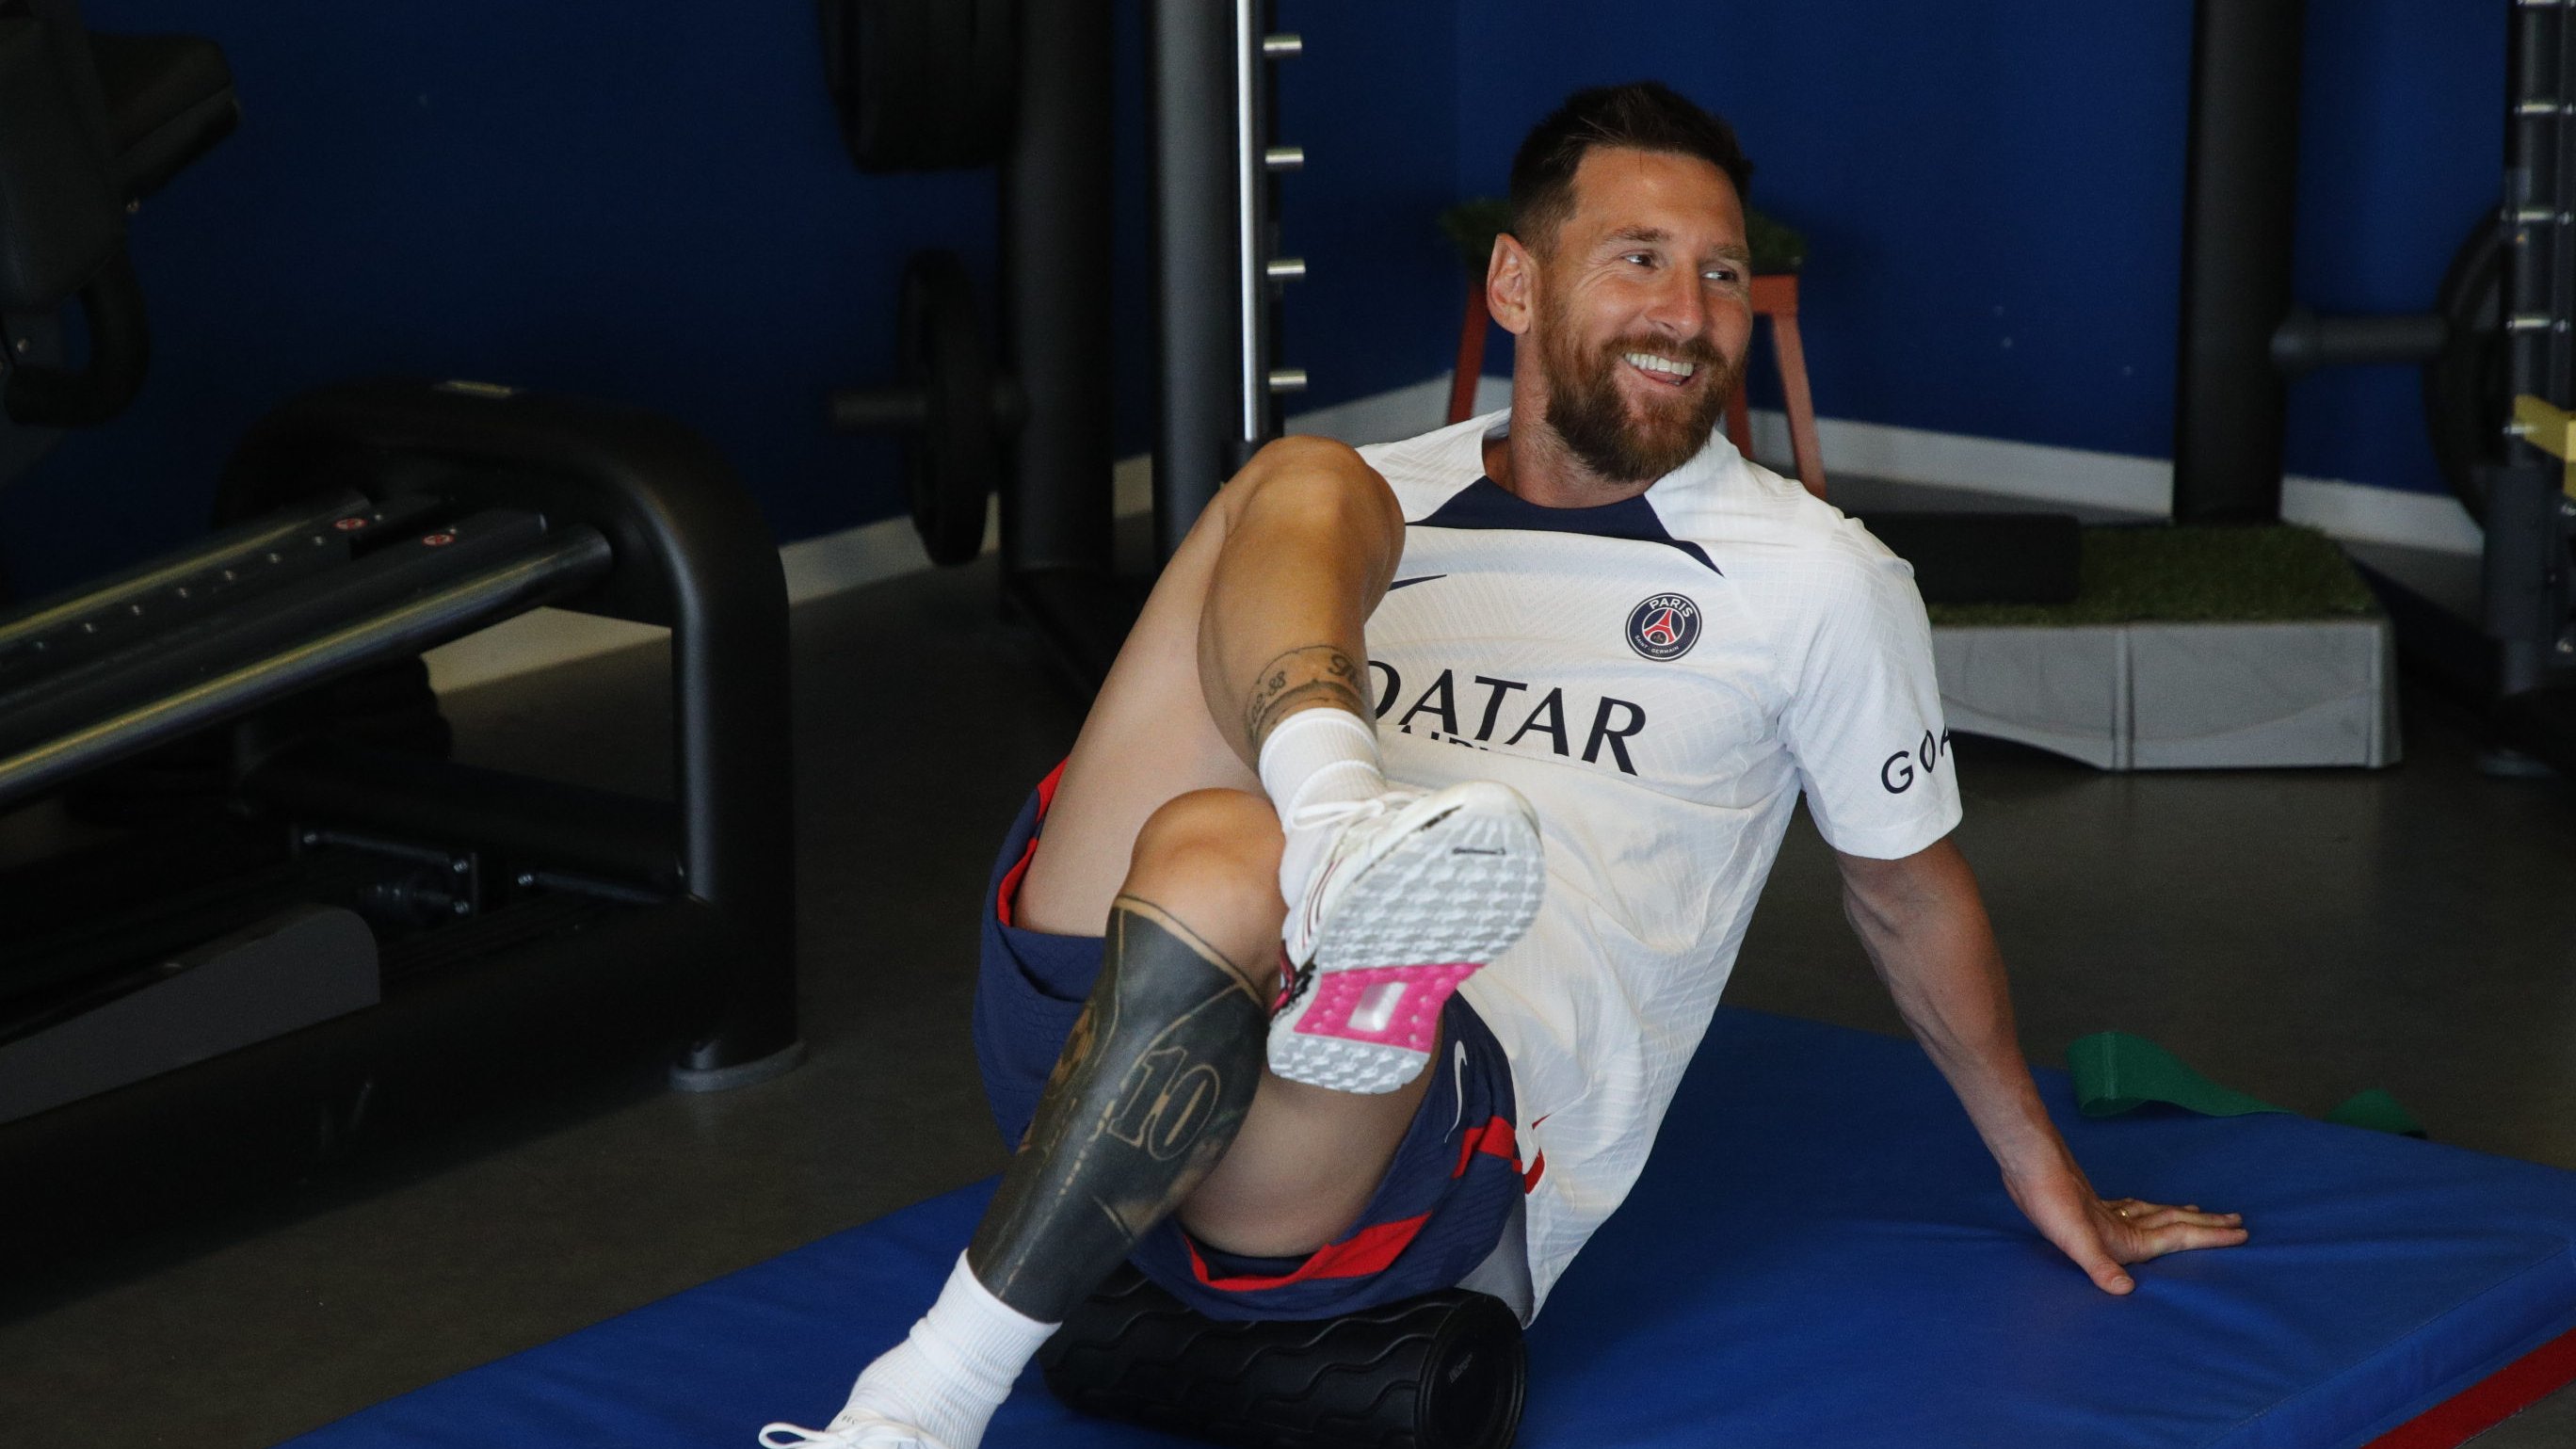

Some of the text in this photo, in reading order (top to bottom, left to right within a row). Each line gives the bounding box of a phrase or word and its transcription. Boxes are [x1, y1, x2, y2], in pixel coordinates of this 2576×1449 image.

[1649, 598, 1693, 618] PARIS
[1650, 646, 1680, 654] GERMAIN
[1106, 1045, 1220, 1161] 10
